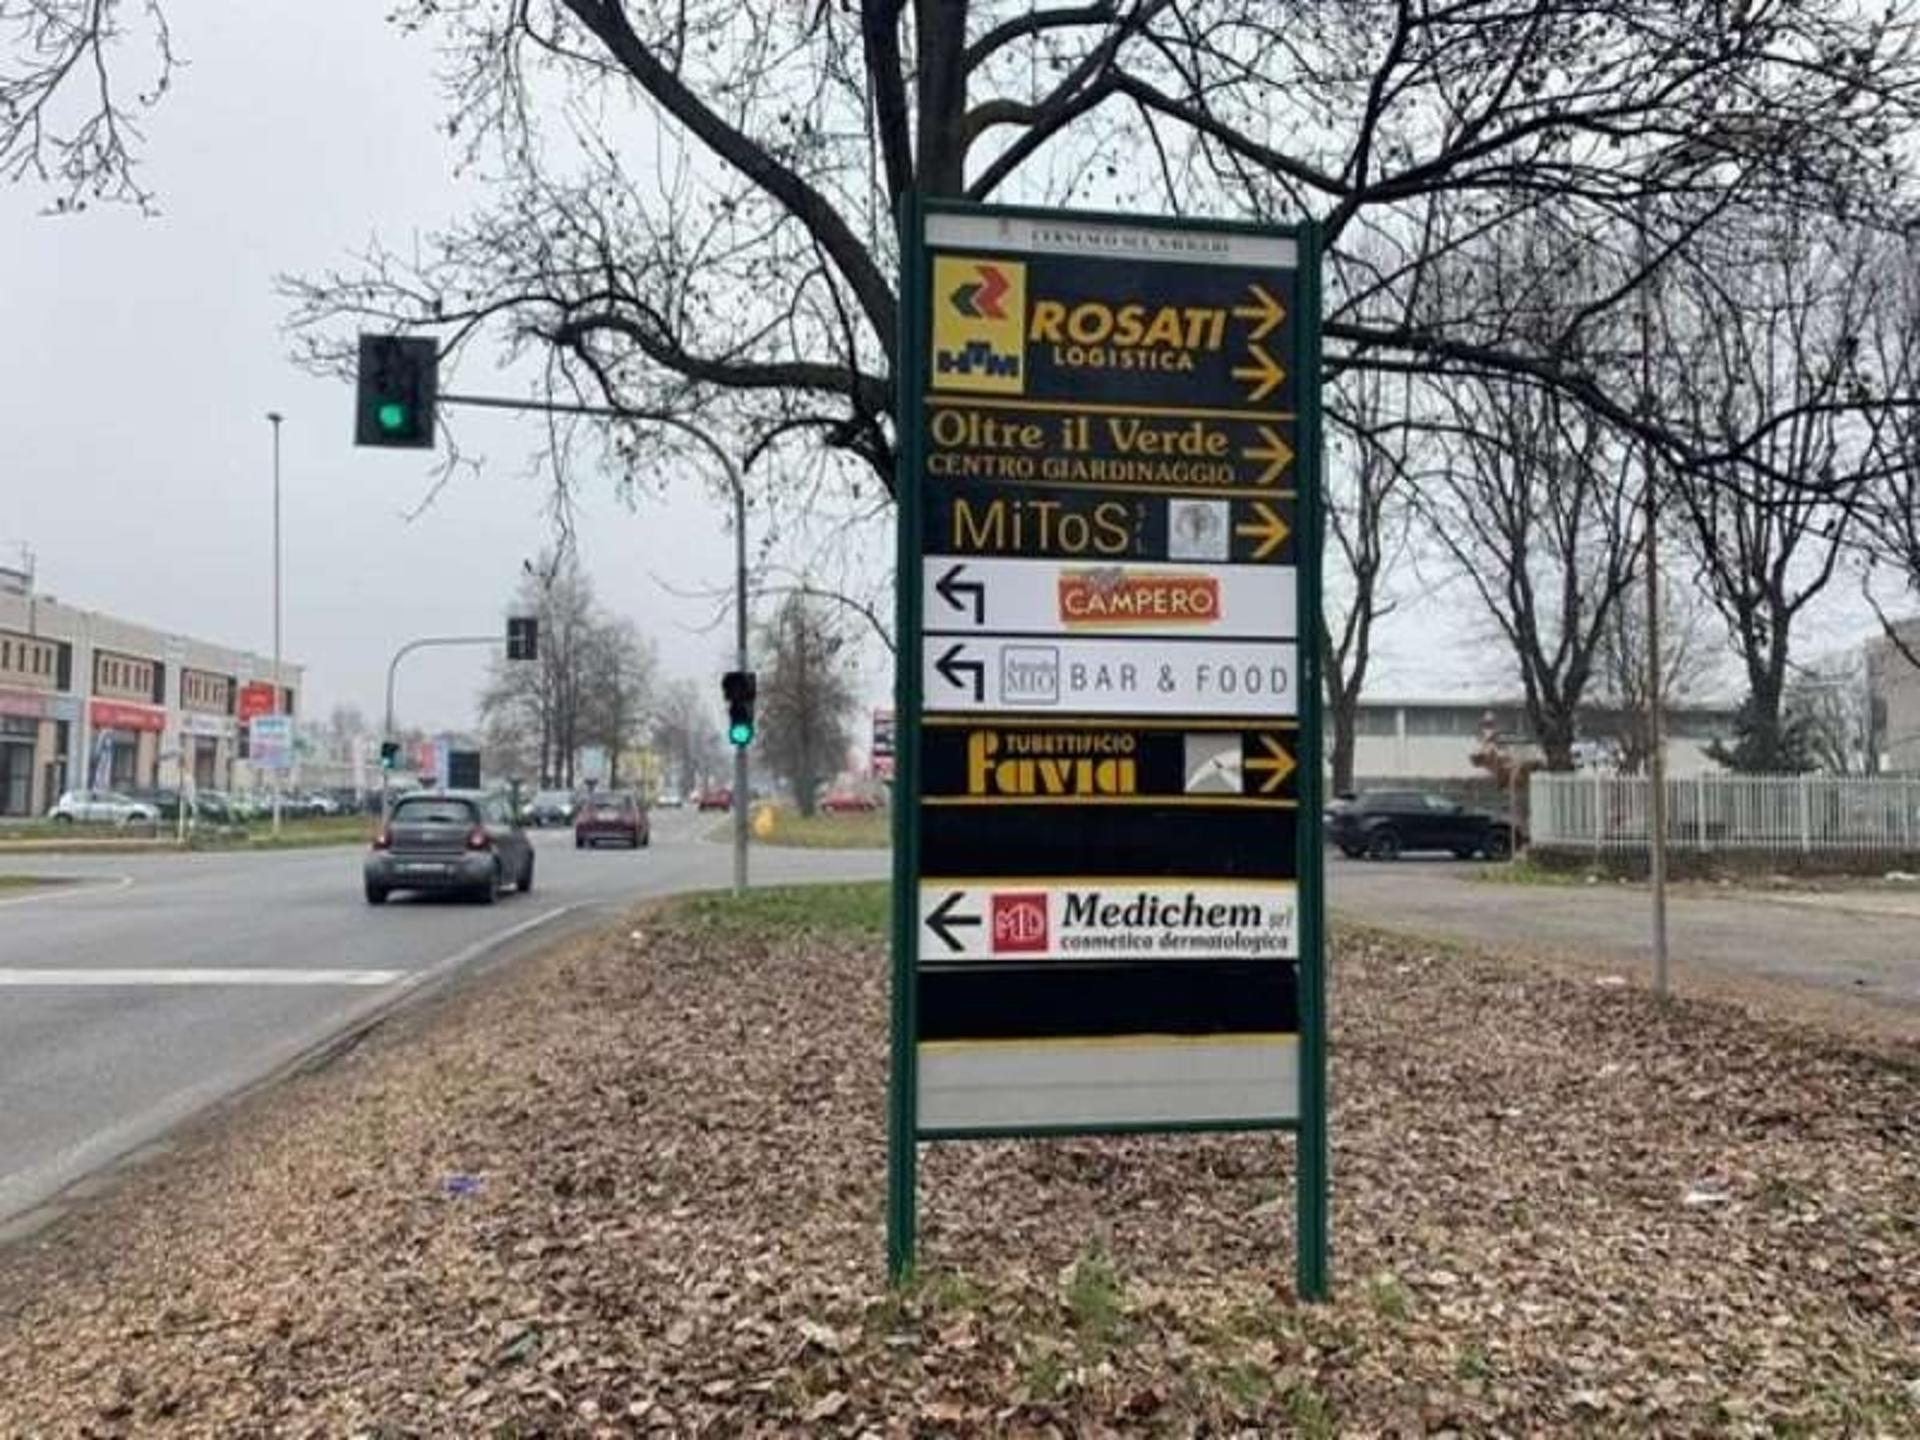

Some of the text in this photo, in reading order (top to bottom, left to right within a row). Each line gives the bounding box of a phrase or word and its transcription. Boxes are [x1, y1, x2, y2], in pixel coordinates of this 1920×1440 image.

[1030, 301, 1227, 350] ROSATI
[1053, 346, 1195, 371] LOGISTICA
[931, 409, 1230, 456] Oltre il Verde
[926, 453, 1235, 484] CENTRO GIARDINAGGIO
[953, 498, 1131, 552] MiToS
[1064, 587, 1214, 615] CAMPERO
[1070, 663, 1138, 691] BAR
[1157, 666, 1176, 693] &
[1197, 665, 1289, 694] FOOD
[1005, 733, 1137, 754] TUBETTIFICIO
[1061, 892, 1262, 928] Medichem
[1158, 933, 1289, 954] dermatologica
